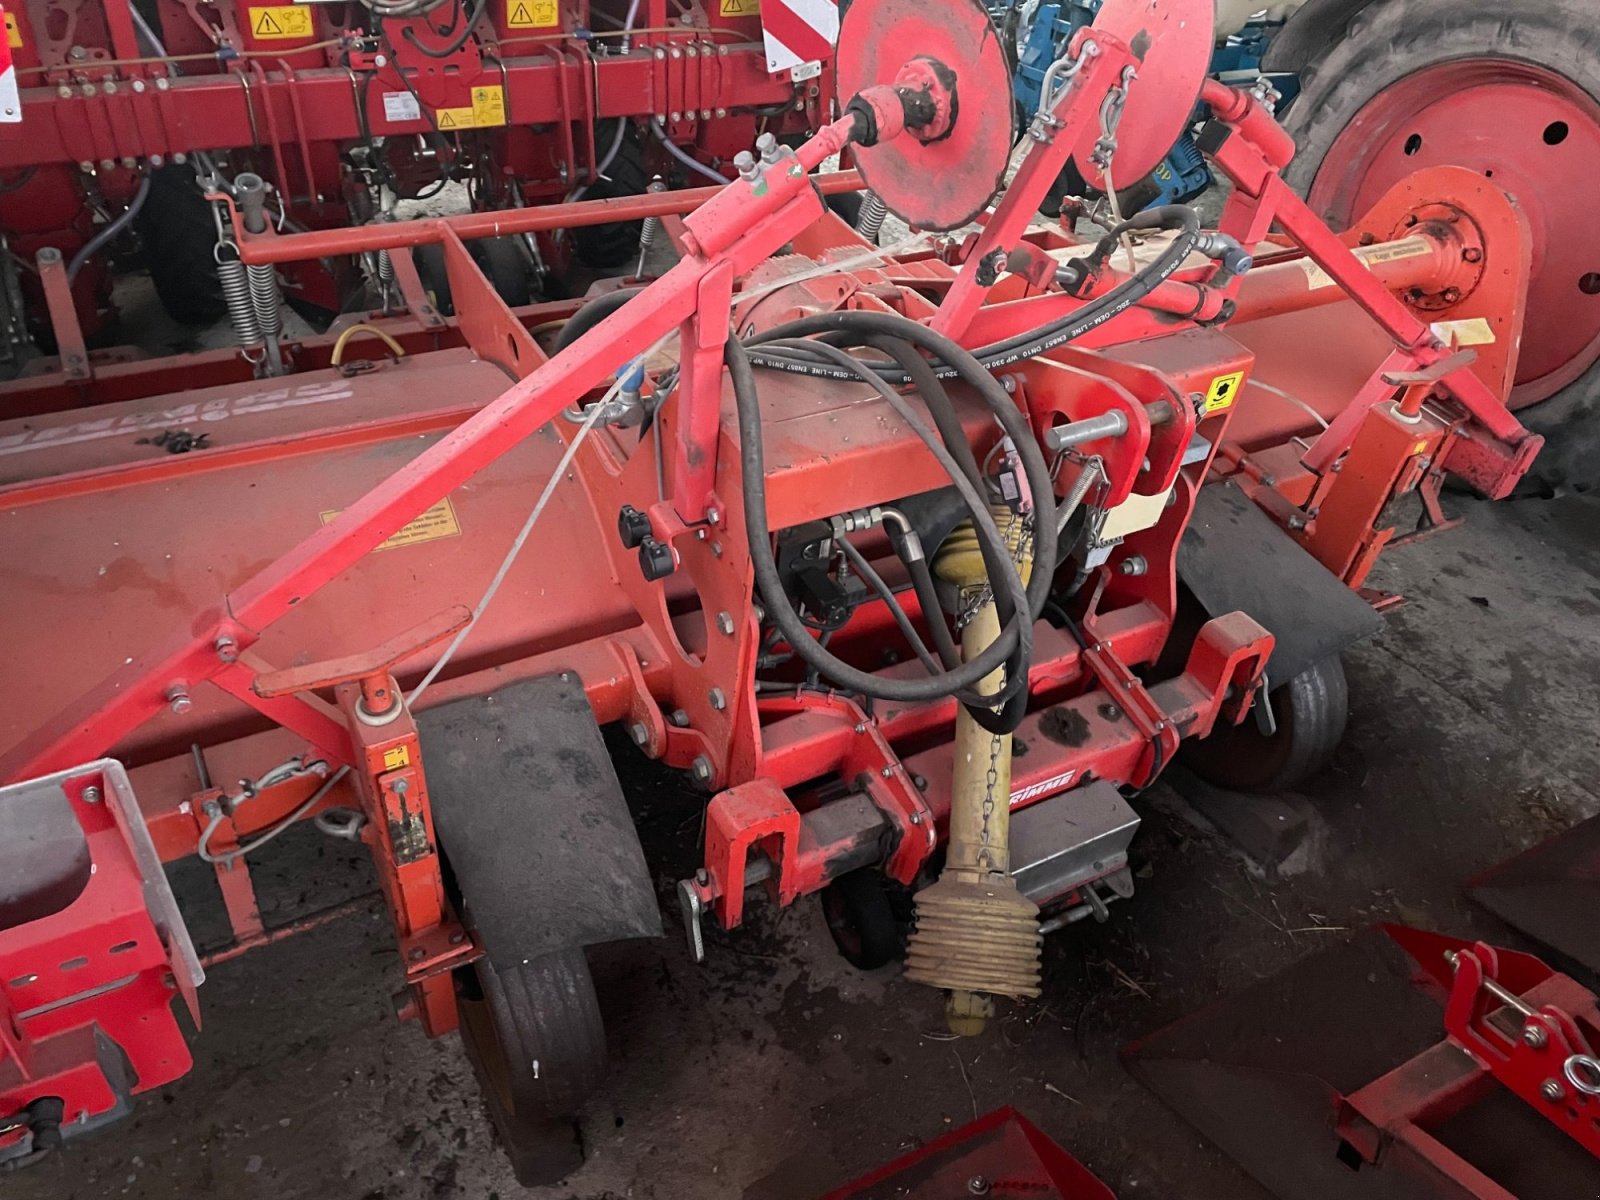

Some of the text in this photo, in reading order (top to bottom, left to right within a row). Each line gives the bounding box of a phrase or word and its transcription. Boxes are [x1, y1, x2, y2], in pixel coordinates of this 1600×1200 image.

[1094, 312, 1110, 325] OEM
[1071, 324, 1088, 337] LINE
[1009, 770, 1075, 805] RIMME
